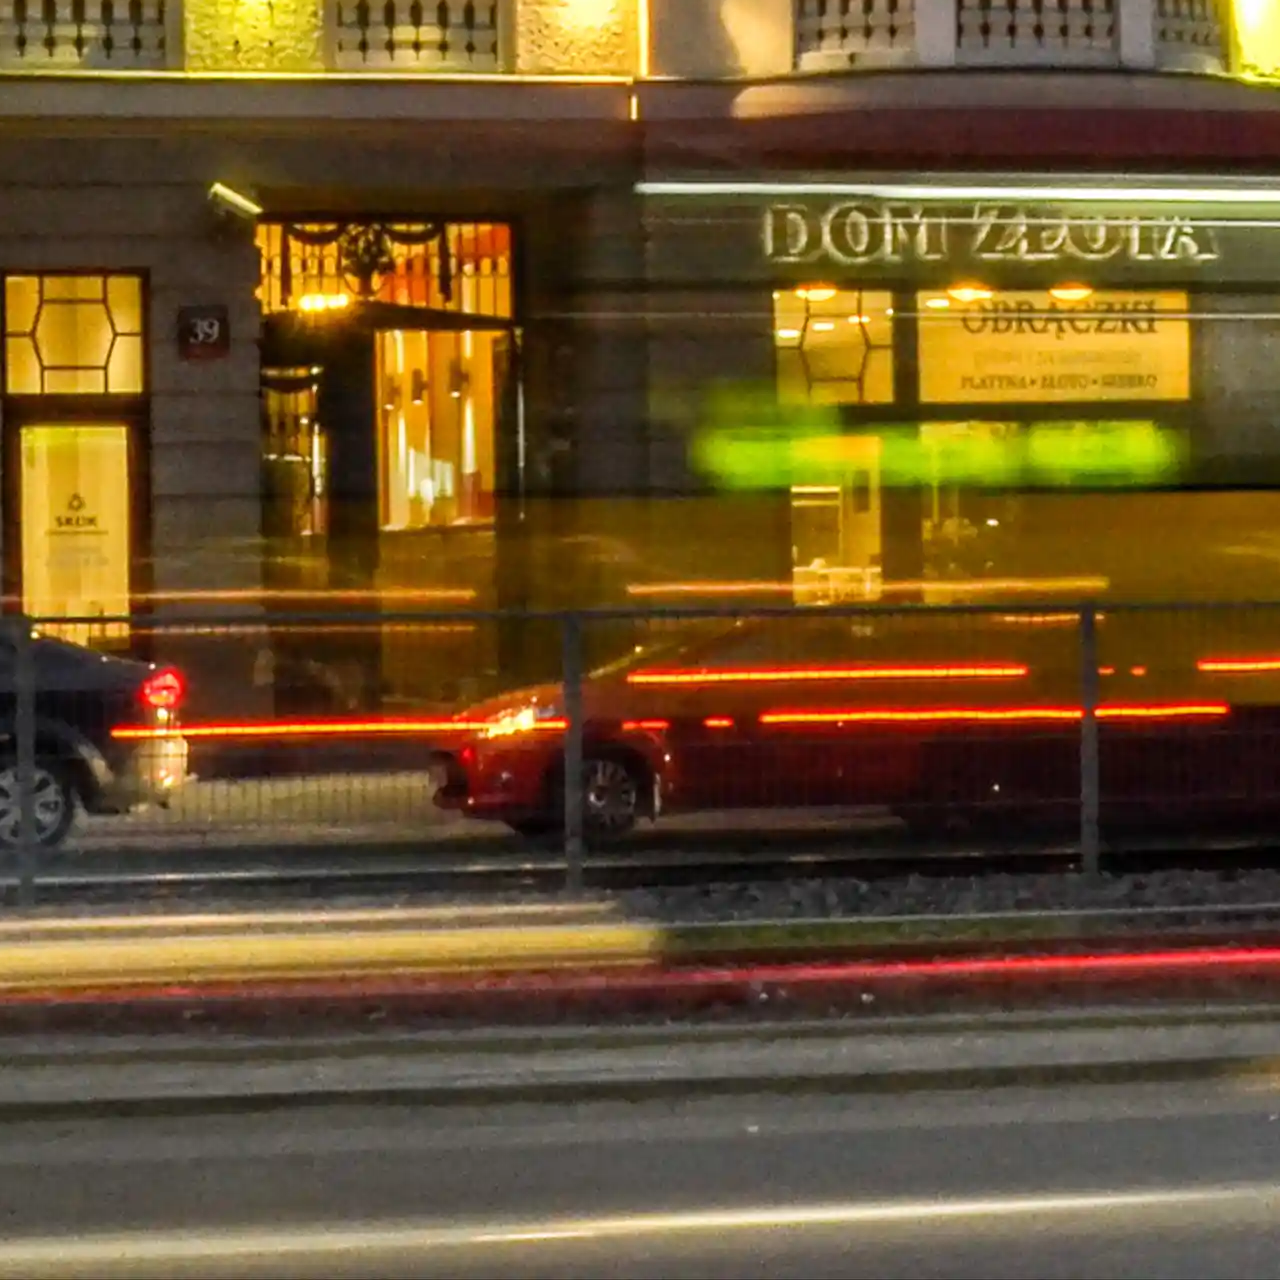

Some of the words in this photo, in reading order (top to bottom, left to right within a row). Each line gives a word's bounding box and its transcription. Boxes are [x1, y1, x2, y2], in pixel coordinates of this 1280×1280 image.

[763, 202, 948, 263] DOM
[189, 319, 220, 344] 39
[960, 298, 1159, 340] OBRĄCZKI
